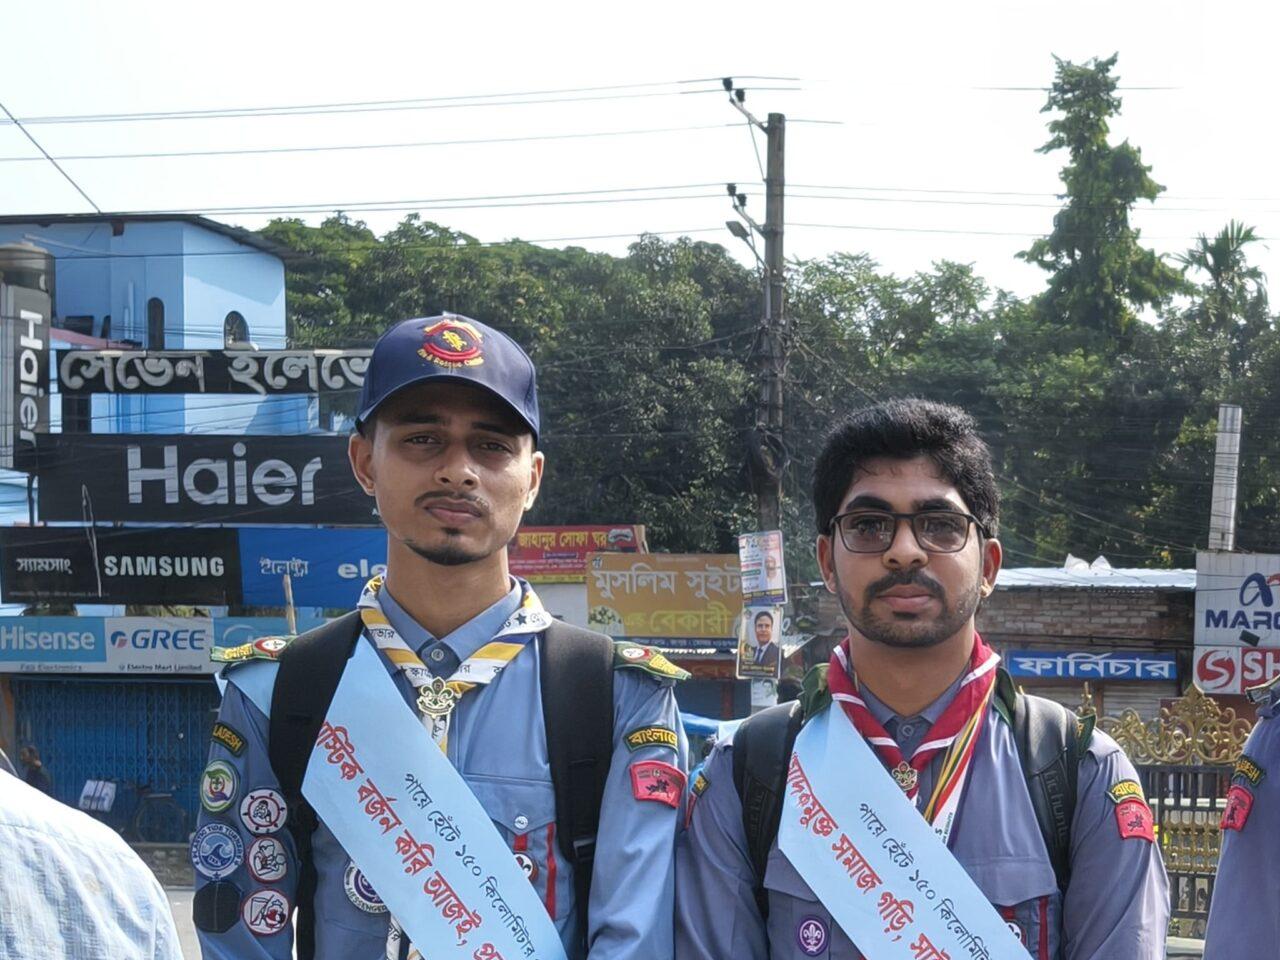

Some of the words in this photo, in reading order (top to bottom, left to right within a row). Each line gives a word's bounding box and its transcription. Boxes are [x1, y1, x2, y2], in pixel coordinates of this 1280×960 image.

[19, 309, 43, 448] Haier
[60, 350, 205, 392] সেভেন
[127, 442, 322, 506] Haier
[104, 555, 225, 577] SAMSUNG
[591, 562, 679, 601] মুসলিম
[0, 625, 96, 651] Hisense
[132, 629, 206, 650] GREE
[1013, 651, 1176, 680] ফার্নিচার
[358, 777, 402, 833] বর্জন
[395, 827, 436, 877] করি
[423, 871, 483, 946] আজই,
[831, 834, 882, 891] সমাজ
[455, 844, 481, 876] ১৫০
[485, 876, 535, 956] কিলোমিটার
[909, 869, 934, 900] ১৫০
